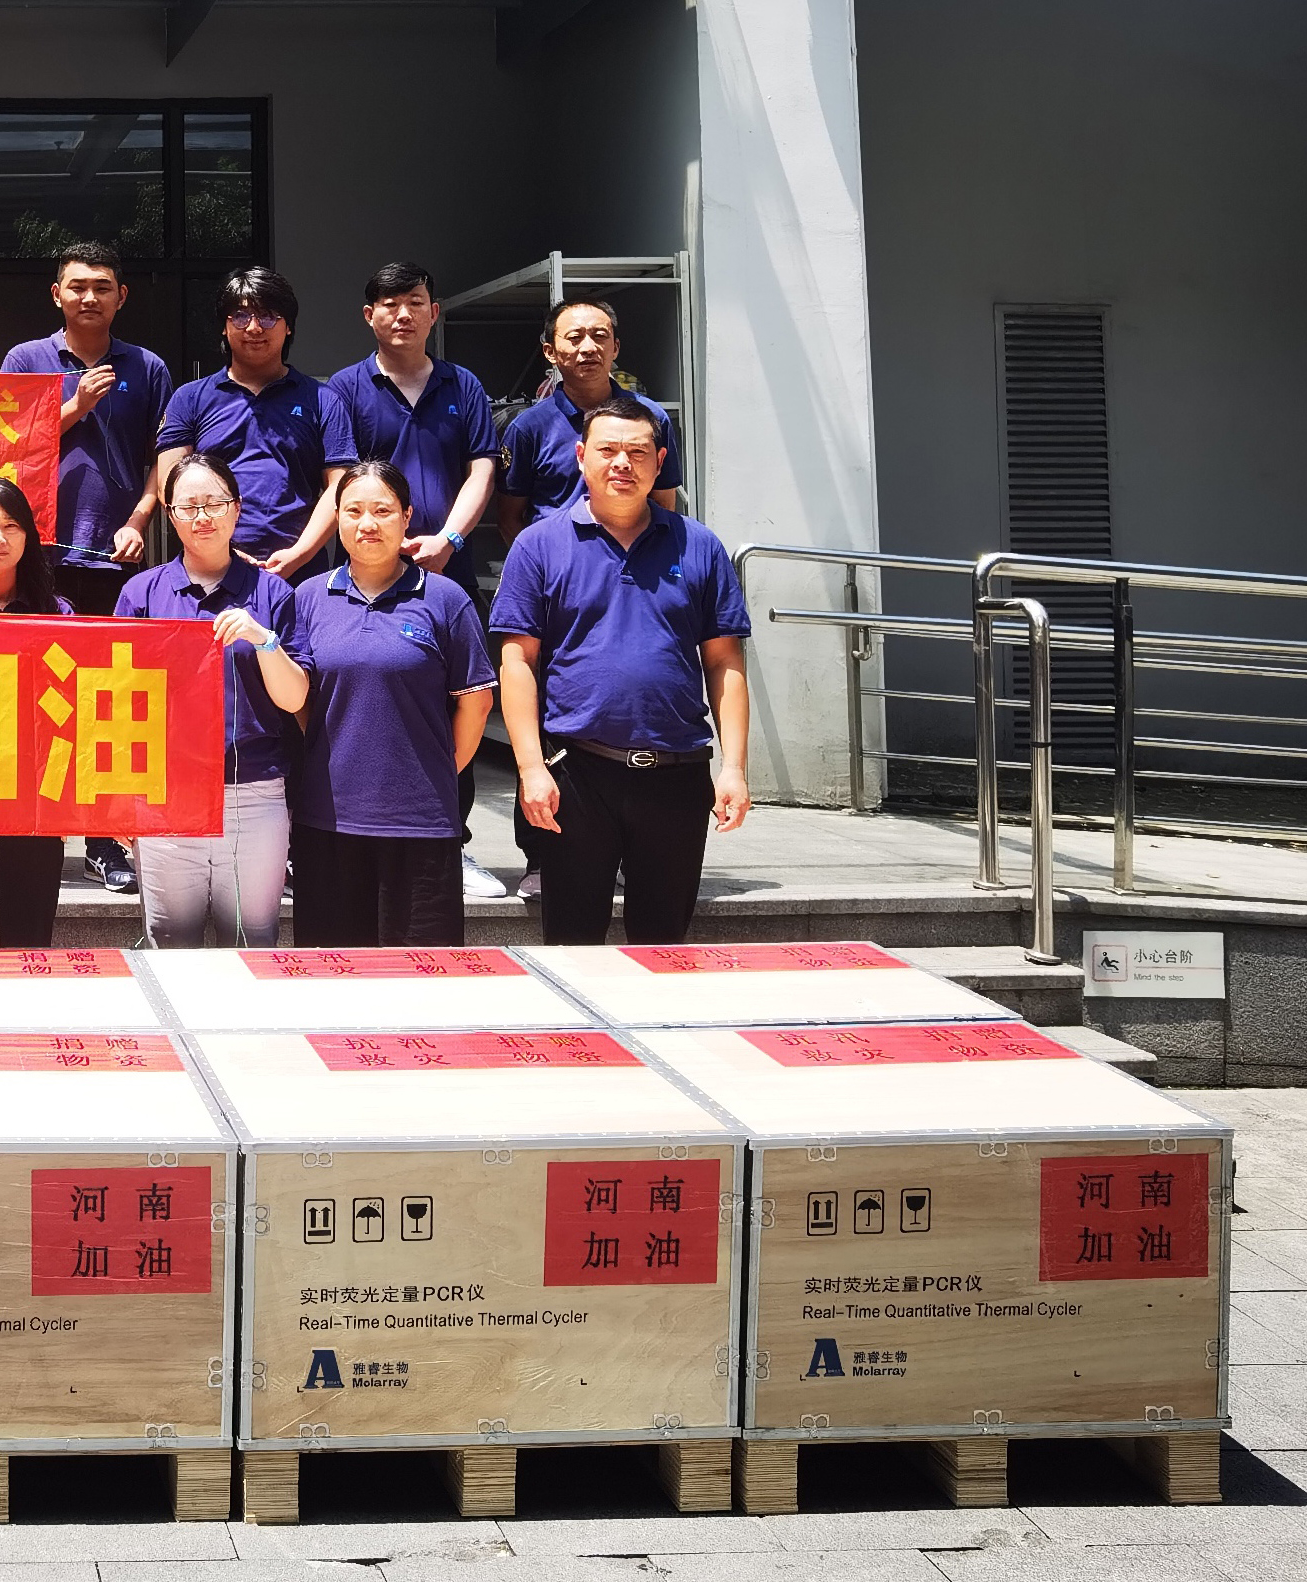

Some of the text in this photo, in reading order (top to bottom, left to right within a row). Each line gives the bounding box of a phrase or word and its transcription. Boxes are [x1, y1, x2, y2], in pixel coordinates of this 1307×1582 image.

[1133, 948, 1193, 964] 小心台阶
[585, 1176, 684, 1214] 河南
[1077, 1171, 1174, 1208] 河南
[71, 1183, 173, 1222] 河南
[582, 1232, 680, 1270] 加油
[1076, 1225, 1172, 1264] 加油
[71, 1240, 172, 1277] 加油
[804, 1275, 982, 1294] 实时荧光定量PCR仪
[300, 1285, 484, 1304] 实时荧光定量PCR仪
[300, 1309, 588, 1330] Real-Time Quantitative Thermal Cycler
[803, 1301, 1082, 1320] Real-Time Quantitative Thermal Cycler
[30, 1316, 78, 1333] Cycler
[853, 1350, 908, 1365] 雅睿生物
[352, 1361, 409, 1376] 雅睿生物
[852, 1366, 907, 1378] Molarray
[352, 1377, 410, 1389] Molarray
